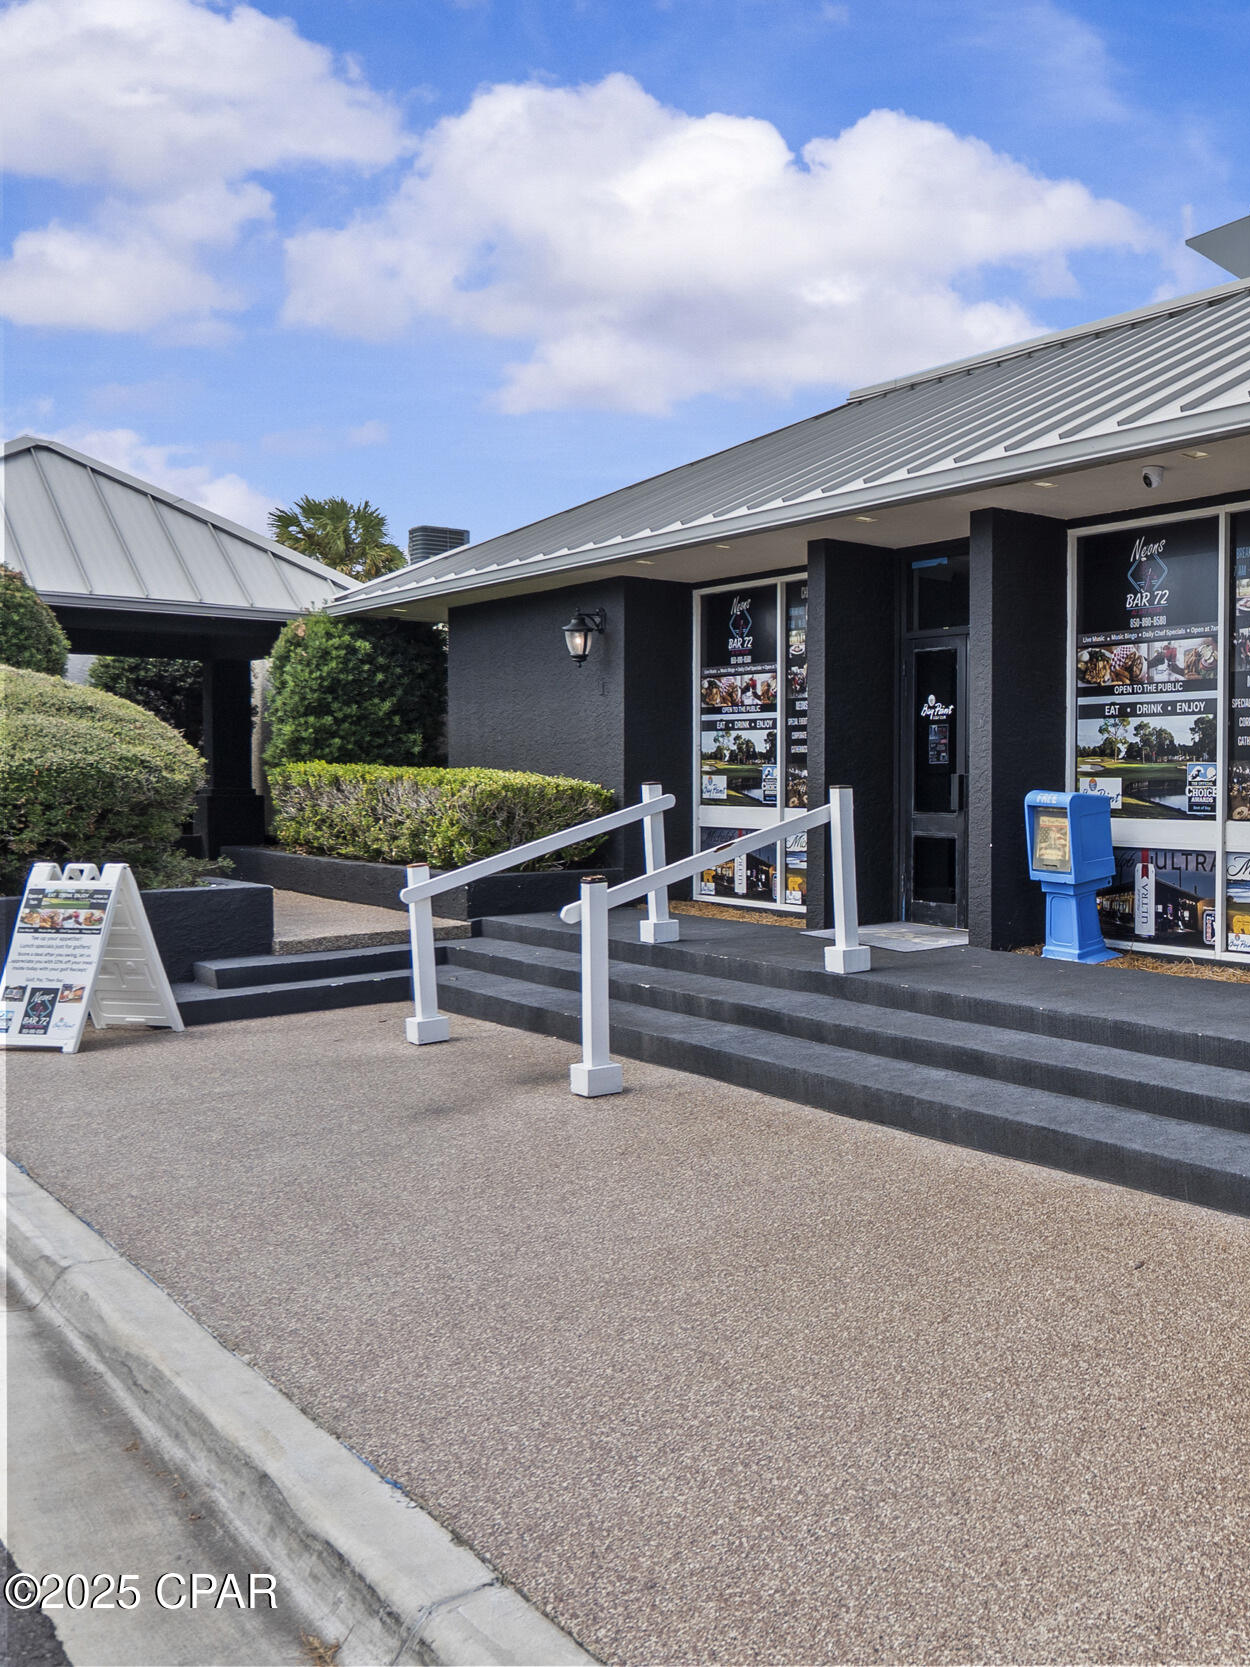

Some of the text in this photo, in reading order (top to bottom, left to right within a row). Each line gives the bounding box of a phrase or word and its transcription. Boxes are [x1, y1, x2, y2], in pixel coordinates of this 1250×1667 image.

[1130, 536, 1166, 561] Neons
[1126, 590, 1169, 608] BAR 72
[1111, 633, 1124, 641] Music
[1125, 633, 1137, 641] Bingo
[1143, 631, 1153, 639] Daily
[1166, 628, 1185, 636] Specials
[729, 636, 753, 649] BAR 72
[1114, 682, 1183, 694] OPEN TO THE PUBLIC
[1105, 701, 1206, 715] EAT DRINK ENJOY
[1232, 698, 1250, 708] SPECIAL
[716, 720, 774, 729] EAT DRINK ENJOY
[1037, 793, 1057, 804] FREE
